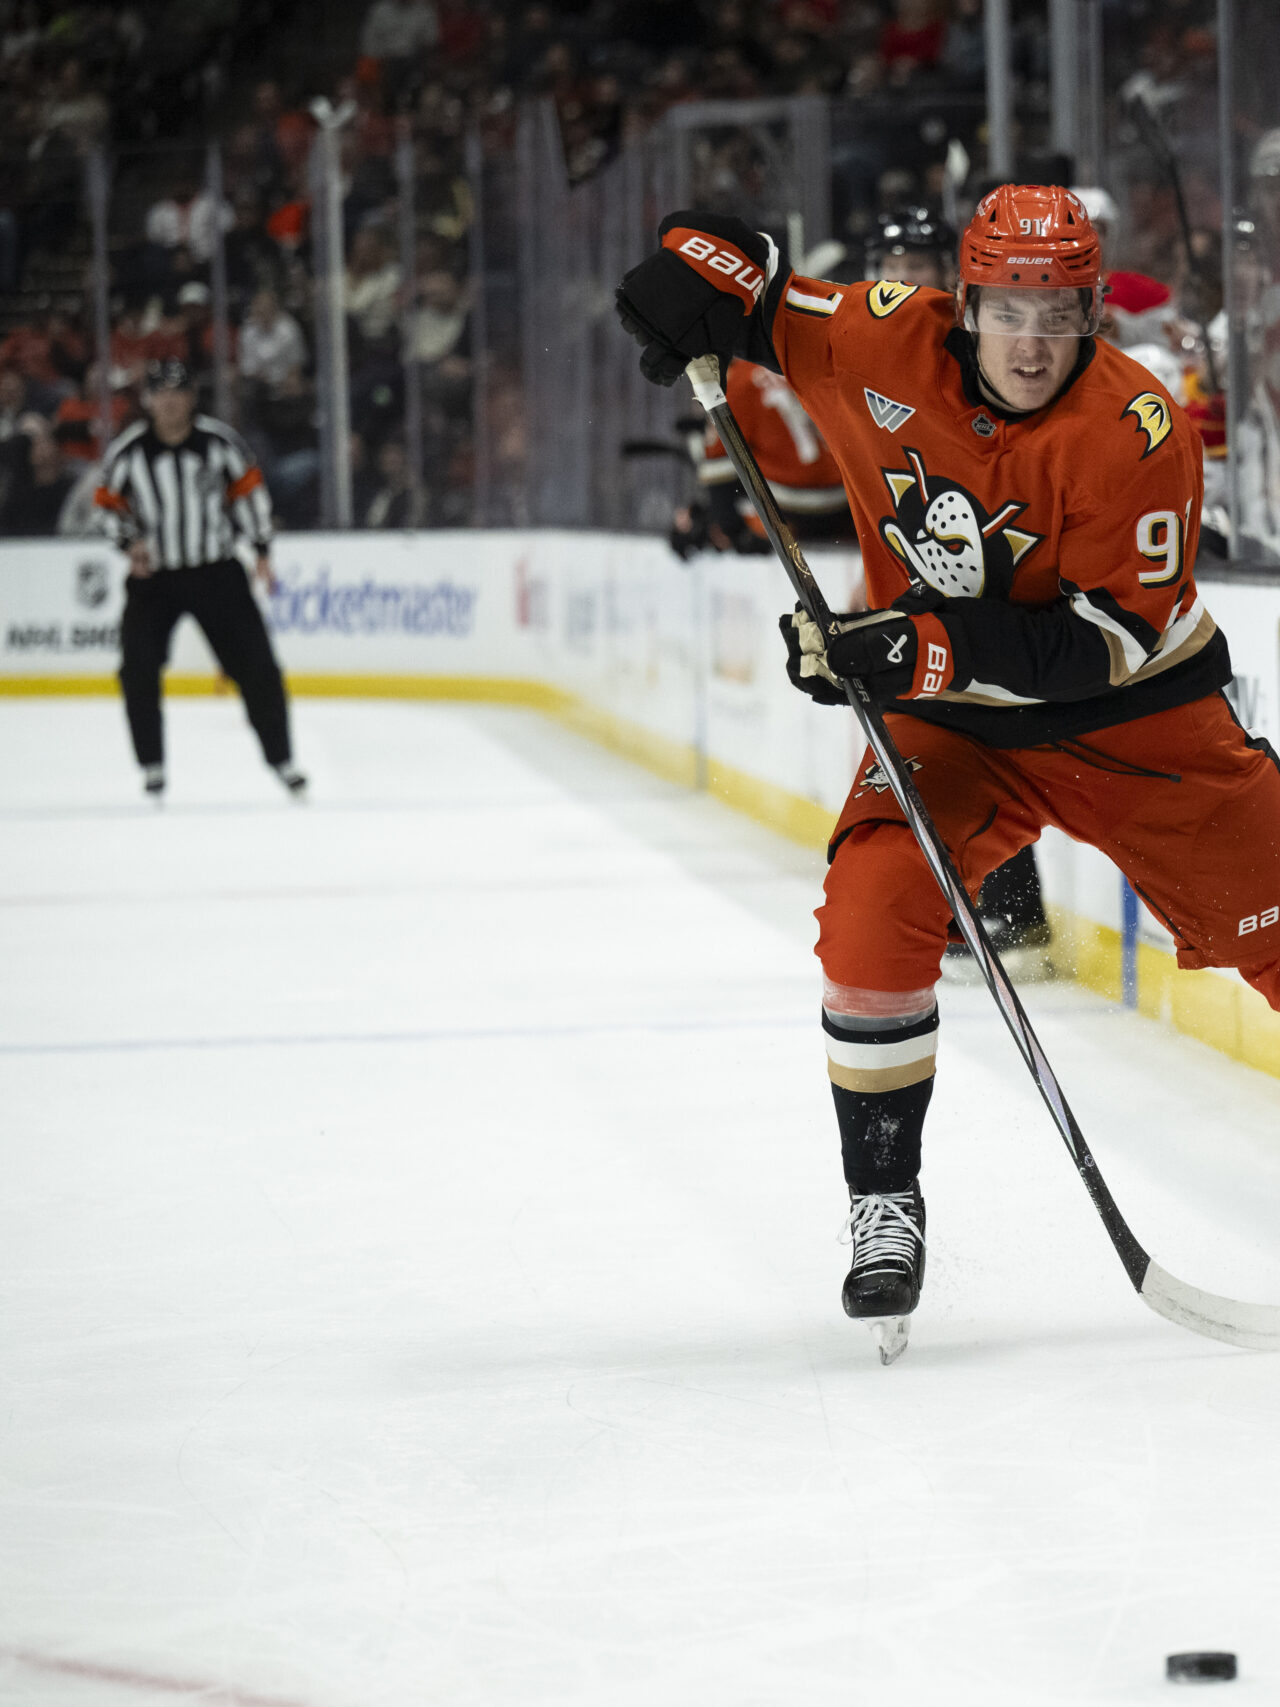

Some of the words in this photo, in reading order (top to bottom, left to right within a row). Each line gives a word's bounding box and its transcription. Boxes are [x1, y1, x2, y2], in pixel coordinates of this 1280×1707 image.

[1020, 218, 1043, 235] 91
[679, 236, 765, 304] BAU
[1006, 256, 1053, 265] BAUER
[1137, 500, 1190, 589] 9
